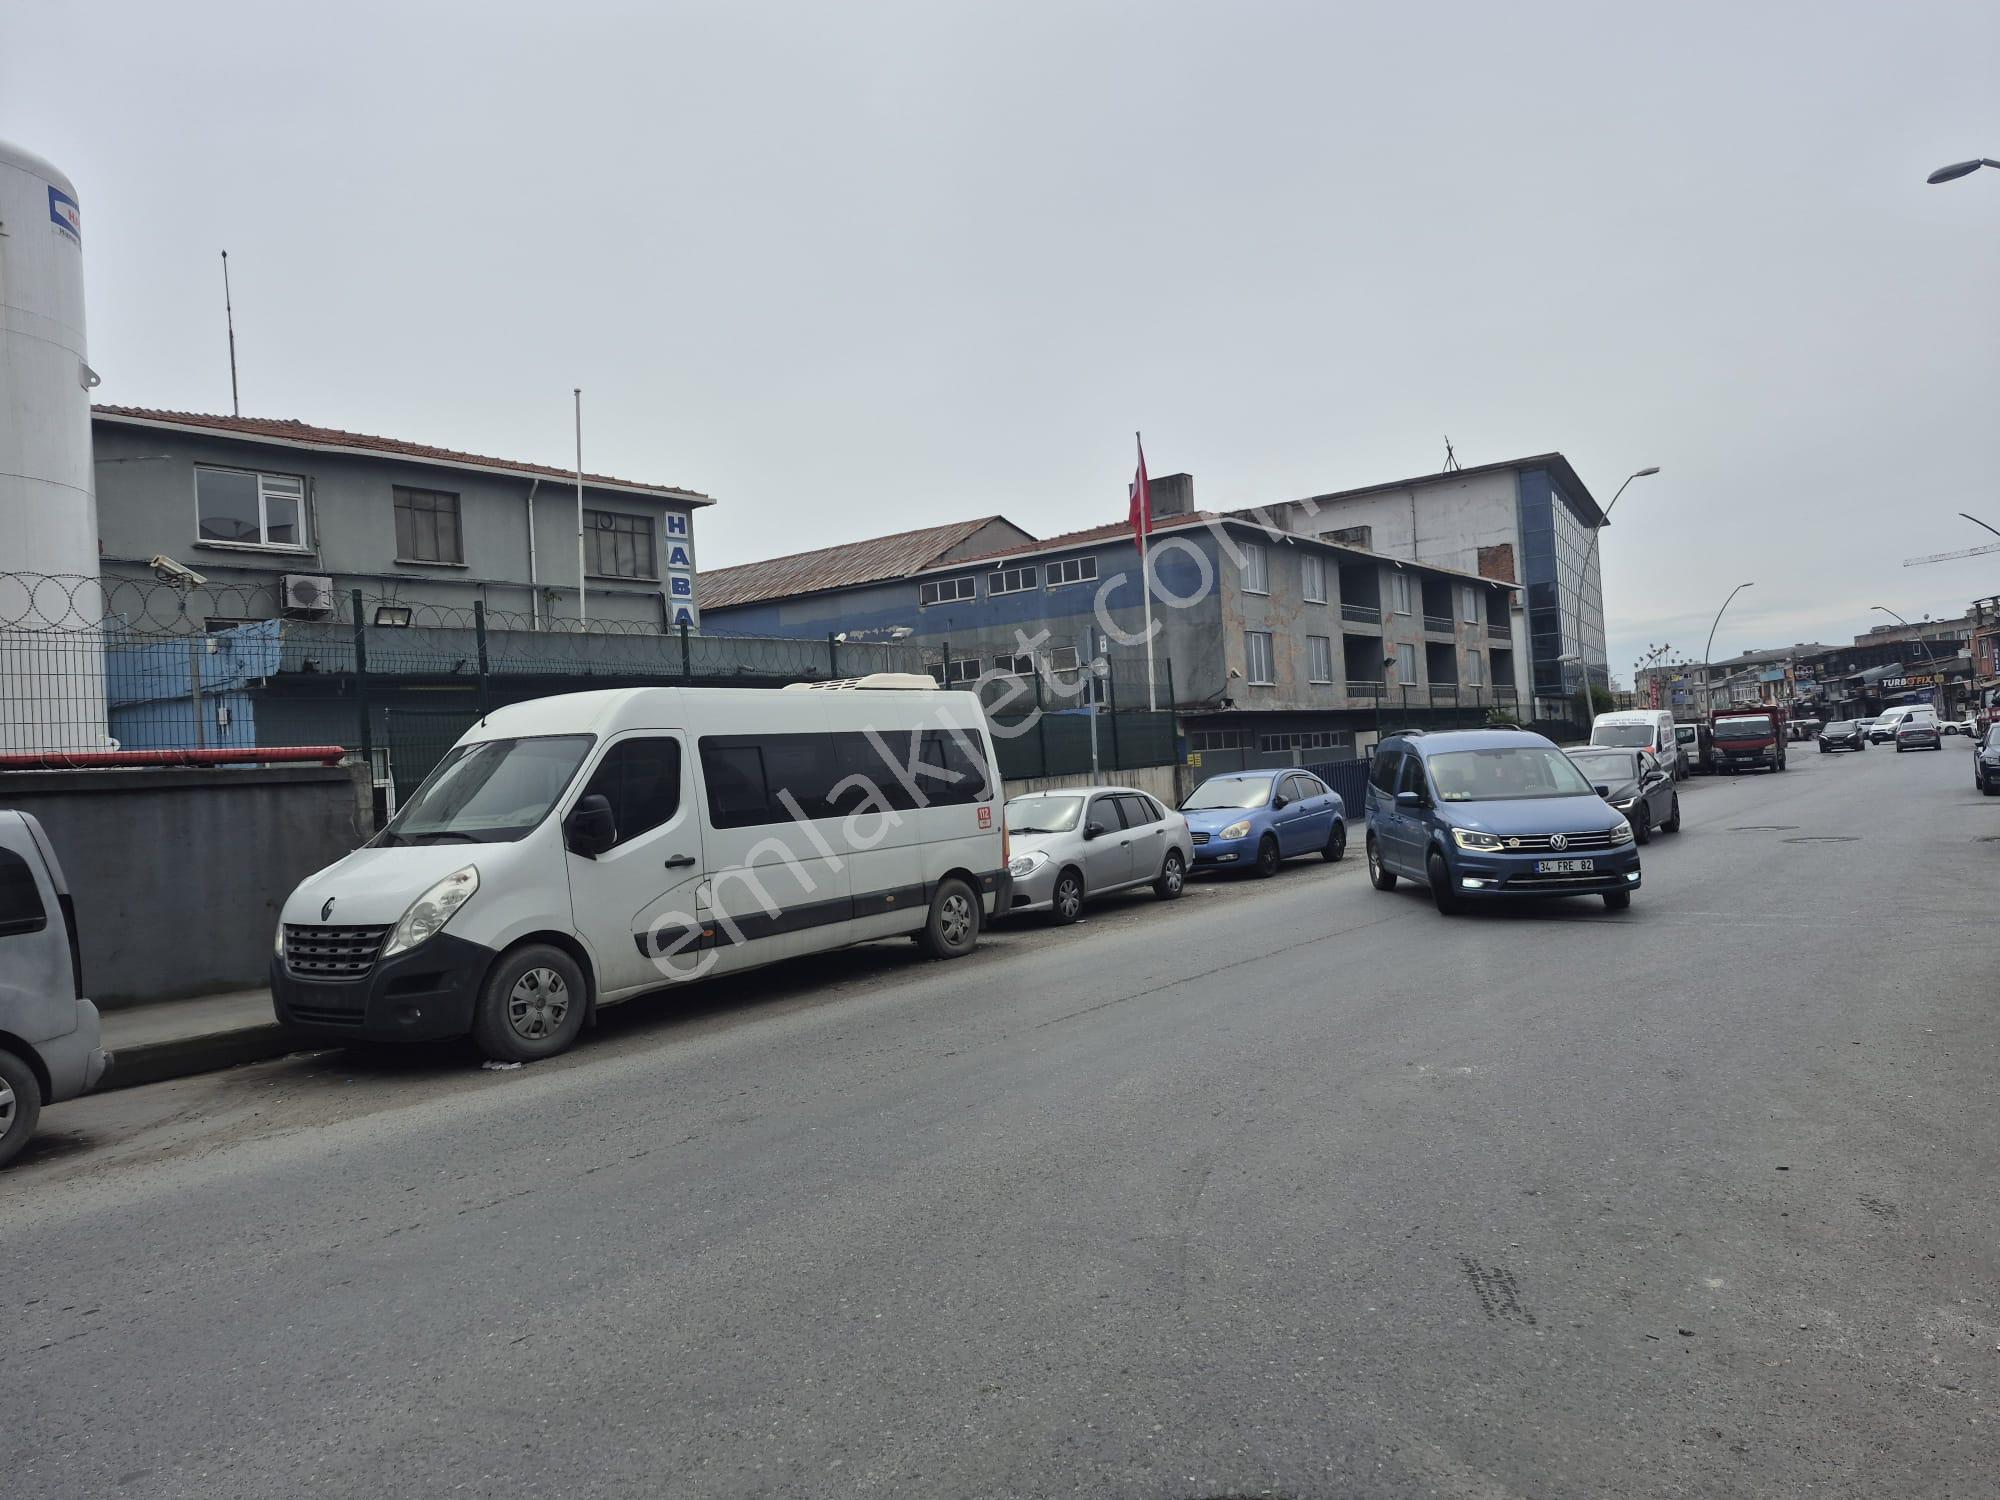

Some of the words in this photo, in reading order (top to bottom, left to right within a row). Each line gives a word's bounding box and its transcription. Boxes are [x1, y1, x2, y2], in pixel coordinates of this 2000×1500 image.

[668, 516, 693, 625] HABA
[979, 808, 989, 819] 112
[1541, 862, 1551, 872] 34
[1557, 861, 1574, 871] FRE
[1581, 860, 1592, 869] 82
